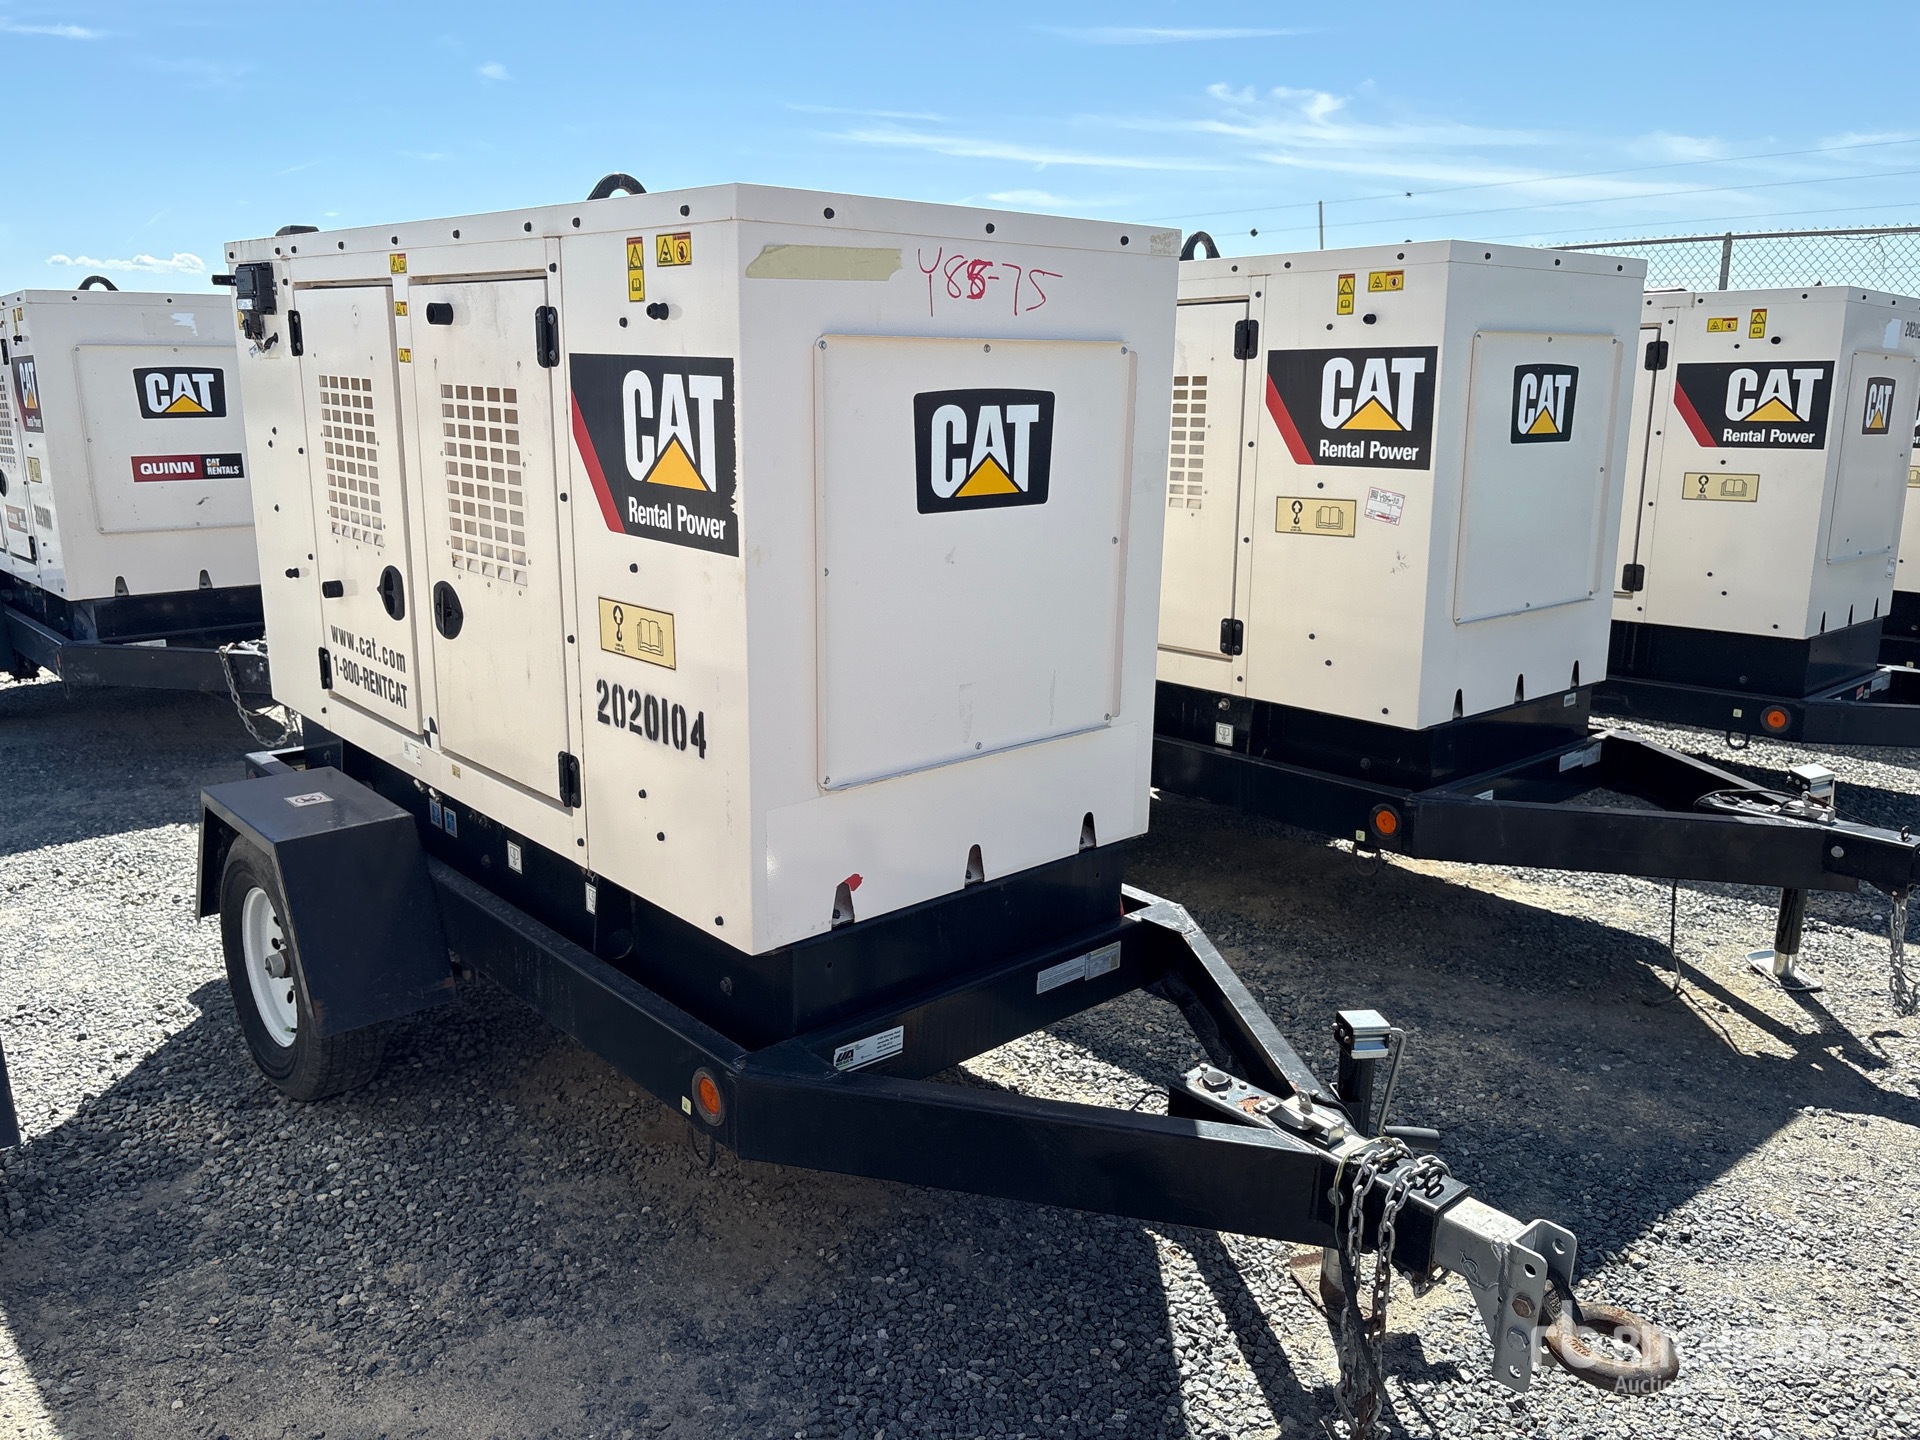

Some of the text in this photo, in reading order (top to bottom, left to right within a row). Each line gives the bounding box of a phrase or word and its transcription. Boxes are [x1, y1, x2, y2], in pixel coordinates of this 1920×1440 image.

[145, 372, 215, 414] CAT
[1320, 357, 1426, 431] CAT
[1517, 373, 1571, 434] CAT
[1725, 368, 1824, 422] CAT
[1865, 384, 1892, 428] CAT
[622, 370, 723, 493] CAT
[931, 404, 1039, 498] CAT
[1319, 439, 1419, 461] Rental Power
[1723, 429, 1815, 444] Rental Power
[140, 462, 195, 474] QUINN
[206, 458, 220, 467] CAT
[207, 466, 240, 475] RENTALS
[628, 497, 726, 541] Rental Power
[331, 625, 406, 673] www.cat.com
[334, 654, 407, 709] 1-800-RENTCAT
[597, 679, 706, 759] 2020104
